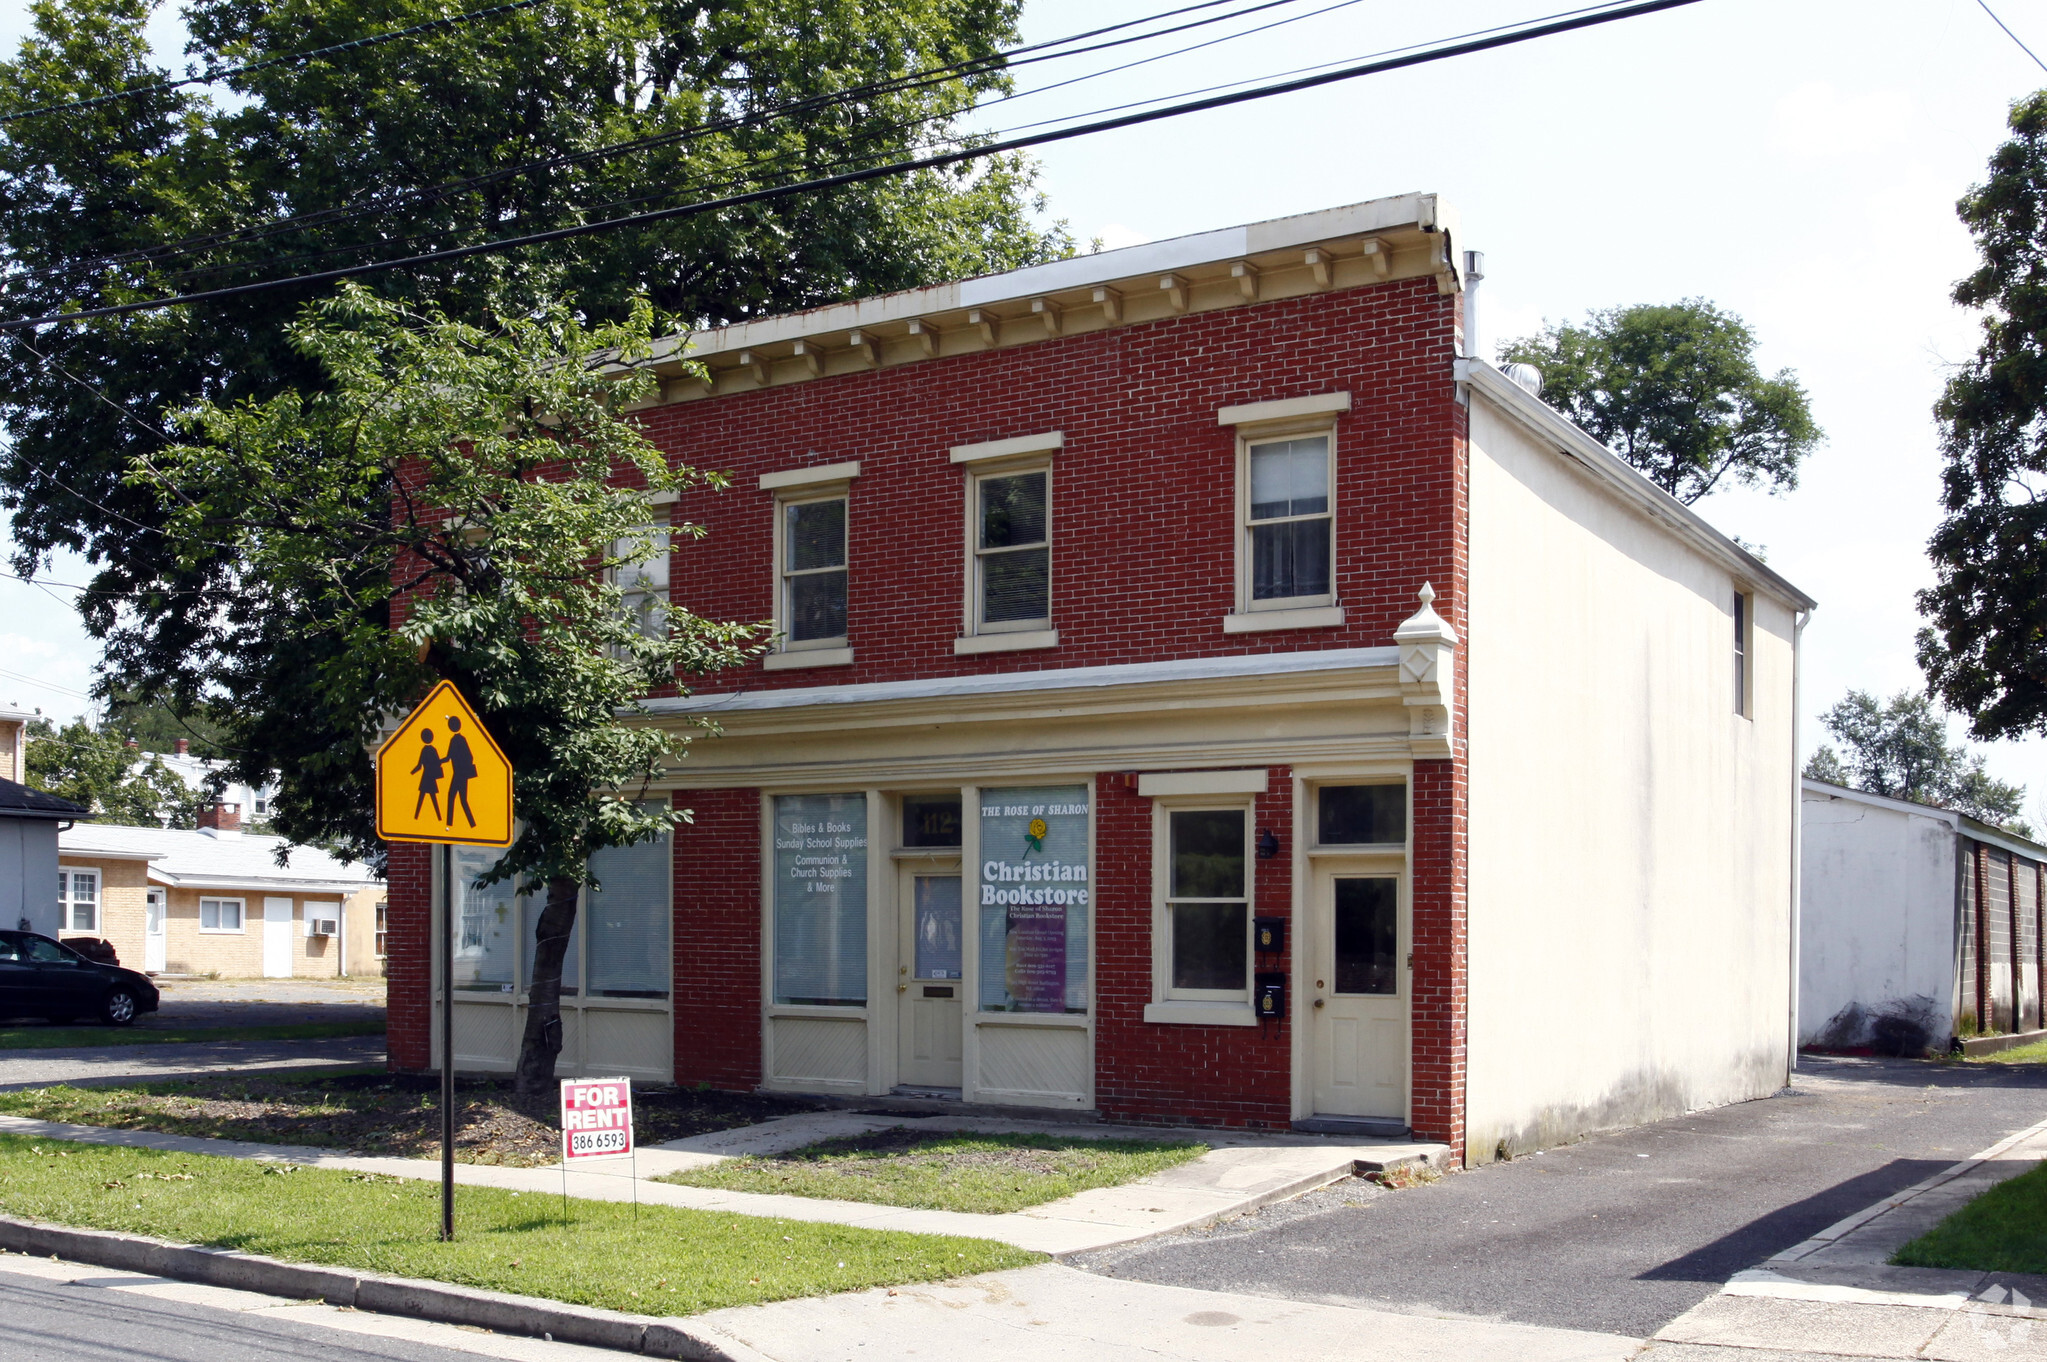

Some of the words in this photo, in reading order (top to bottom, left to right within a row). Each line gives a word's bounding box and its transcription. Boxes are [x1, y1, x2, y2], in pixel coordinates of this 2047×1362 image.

[981, 806, 1000, 817] THE
[1004, 806, 1029, 816] ROSE
[1032, 805, 1045, 816] OF
[1048, 804, 1088, 815] SHARON
[792, 823, 816, 834] Bibles
[818, 822, 824, 833] &
[826, 822, 852, 833] Books
[924, 811, 954, 835] 112
[776, 838, 804, 850] Sunday
[806, 837, 833, 849] School
[834, 836, 868, 850] Supplies
[795, 854, 839, 866] Communion
[841, 854, 848, 865] &
[790, 867, 817, 878] Church
[819, 866, 852, 879] Supplies
[983, 861, 1088, 882] Christian
[807, 882, 813, 892] &
[815, 882, 835, 893] More
[981, 884, 1089, 906] Bookstore
[1035, 912, 1065, 920] Bookstore
[574, 1086, 620, 1108] FOR
[567, 1108, 627, 1131] RENT
[573, 1134, 594, 1150] 386
[596, 1132, 625, 1148] 6593
